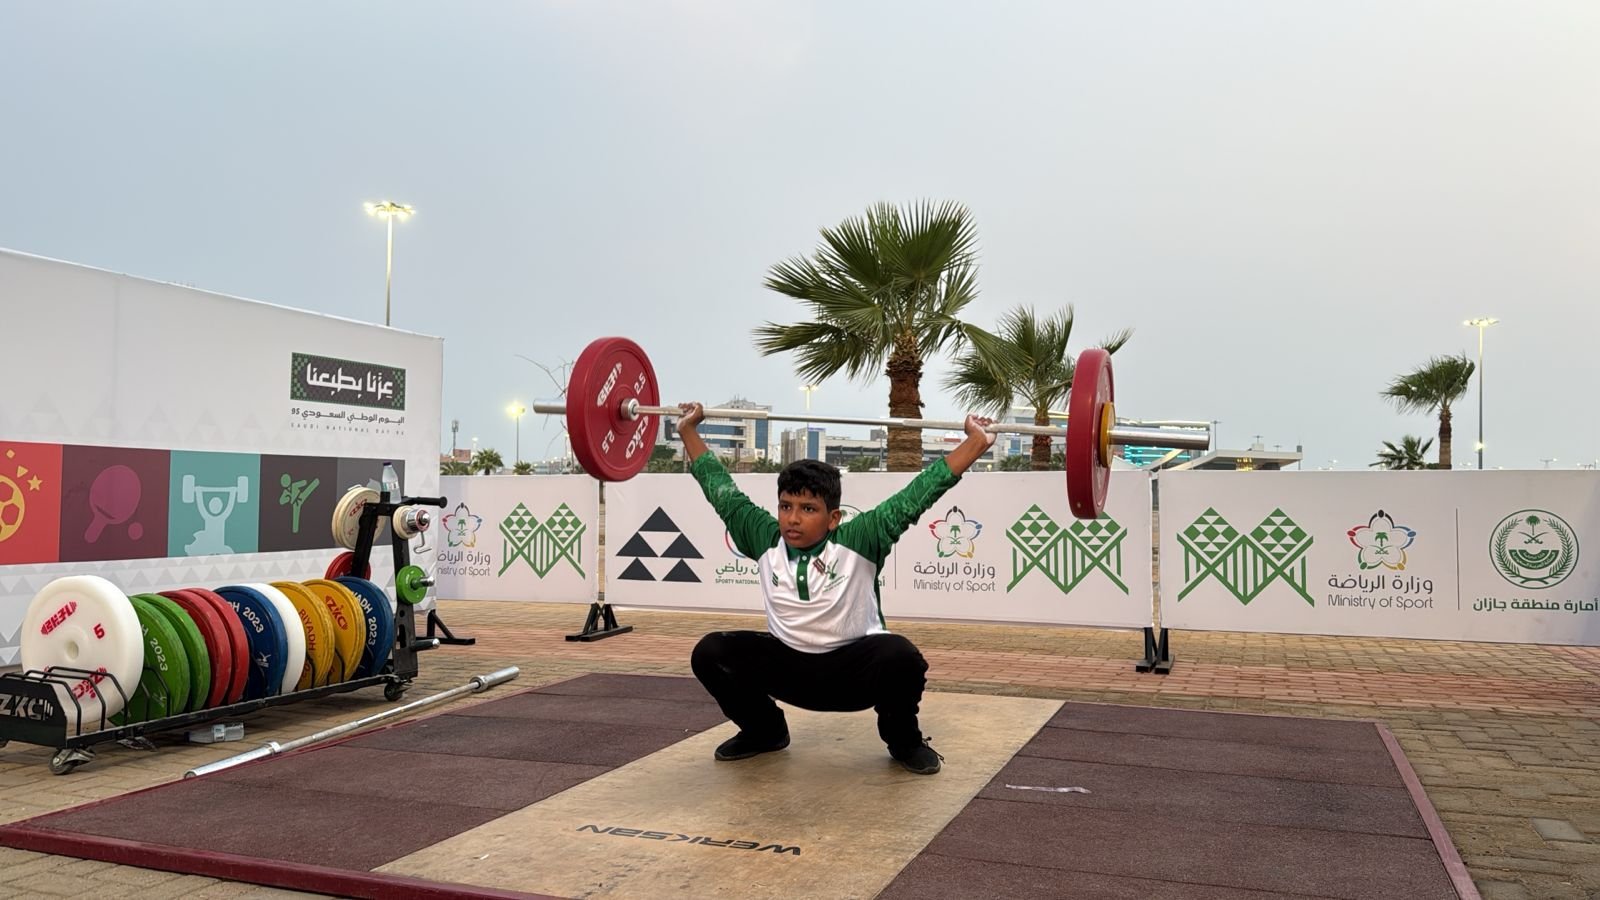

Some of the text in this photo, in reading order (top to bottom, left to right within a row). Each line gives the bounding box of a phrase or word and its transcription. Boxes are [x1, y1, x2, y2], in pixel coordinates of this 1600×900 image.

[306, 363, 362, 398] بطبعنا
[301, 409, 345, 420] السعودي
[347, 413, 378, 424] الوطني
[378, 416, 404, 425] اليوم
[437, 551, 491, 565] وزارة الرياض
[437, 566, 490, 577] nistry of Sport
[715, 559, 748, 578] رياضي
[913, 561, 996, 579] وزارة الرياضة
[913, 579, 996, 593] Ministry of Sport
[1328, 574, 1433, 594] وزارة الرياضة
[1328, 594, 1433, 611] Ministry of Sport
[1473, 598, 1599, 614] أمارة منطقة جازان
[242, 606, 264, 633] 2023
[93, 622, 105, 640] 5
[299, 608, 316, 651] RIYADH
[368, 616, 378, 646] 2023
[150, 637, 168, 672] 2023
[575, 824, 801, 856] WERKSAN
